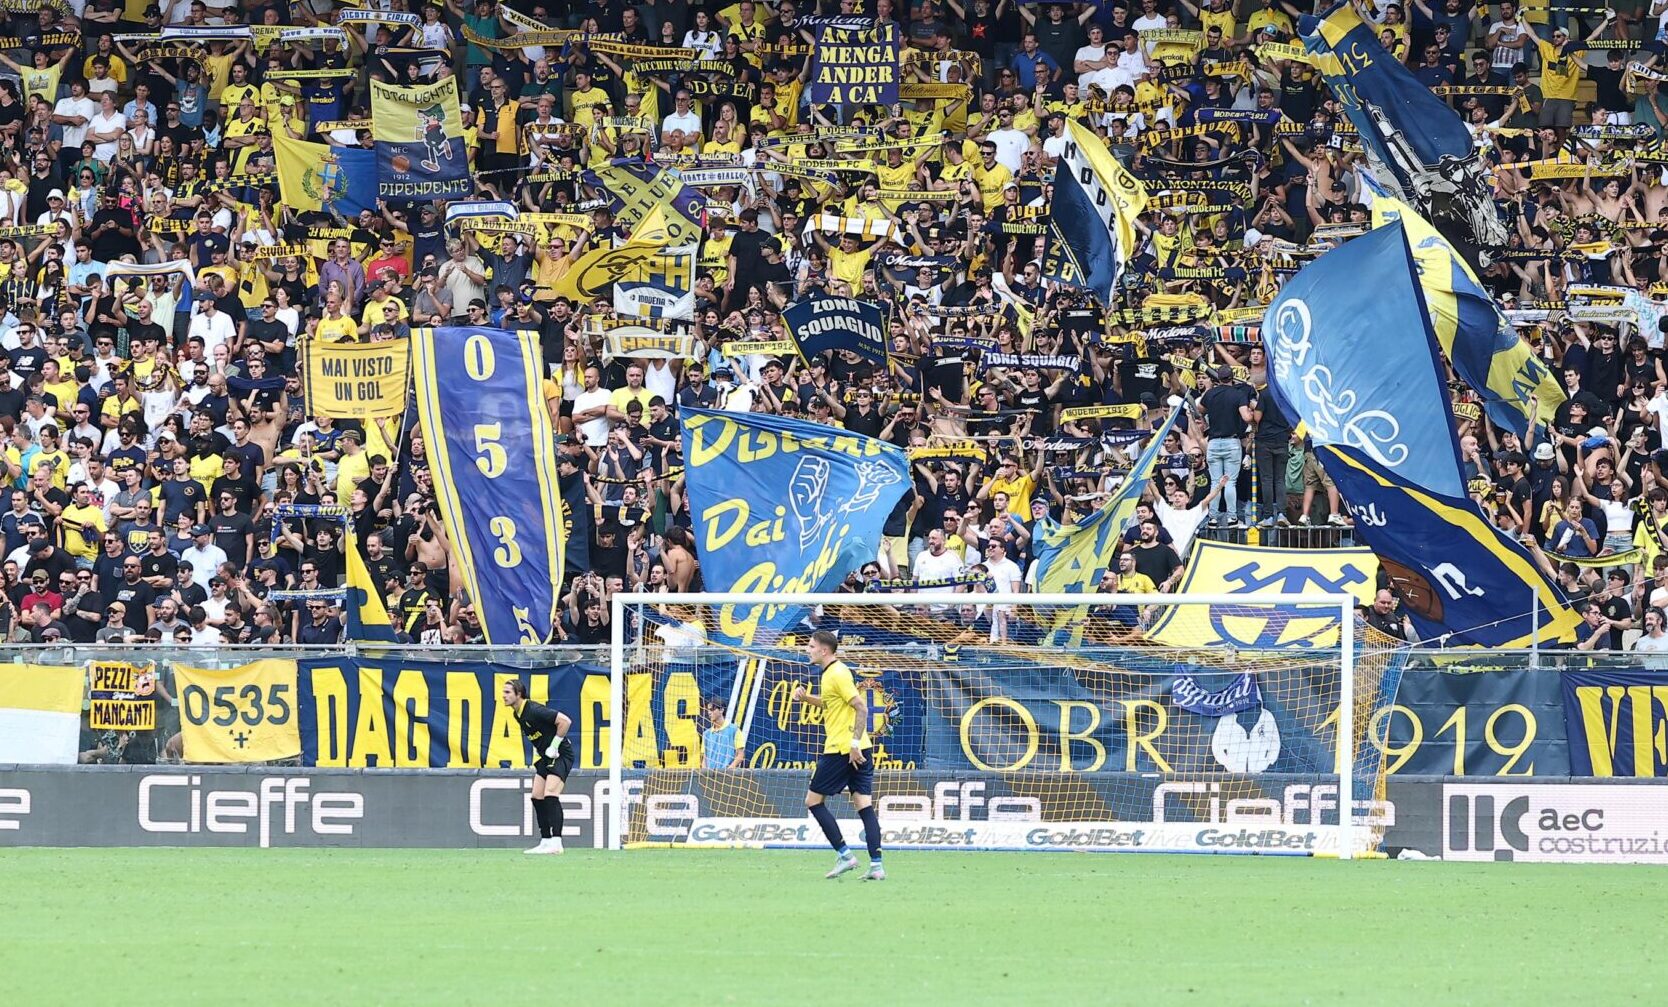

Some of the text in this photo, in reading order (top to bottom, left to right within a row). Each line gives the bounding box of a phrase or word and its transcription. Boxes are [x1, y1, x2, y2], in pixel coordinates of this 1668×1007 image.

[820, 26, 848, 43] AN
[819, 45, 896, 64] MENGA
[634, 60, 673, 73] VECCHIE
[817, 66, 893, 84] ANDER
[373, 81, 454, 106] TOTALMENTE
[827, 85, 884, 103] A CA'
[390, 146, 409, 154] MFC
[855, 140, 899, 149] MODENA
[798, 160, 860, 169] MODENA FC
[393, 173, 410, 181] 1912
[379, 178, 469, 197] DIPENDENTE
[811, 299, 861, 314] ZONA
[797, 315, 884, 343] SQUAGLIO
[321, 355, 393, 378] MAI VISTO
[334, 381, 383, 401] UN GOL
[702, 498, 787, 552] Dai
[94, 666, 132, 690] PEZZI
[93, 702, 152, 727] MANCANTI
[182, 683, 290, 727] 0535
[311, 668, 431, 769] DAG
[579, 671, 704, 769] GAS
[960, 696, 1175, 773] OBR
[137, 774, 365, 849] Cieffe
[469, 778, 699, 851] Cieffe
[691, 823, 810, 844] GoldBet
[1025, 827, 1147, 847] GoldBet
[1195, 828, 1318, 849] GoldBet
